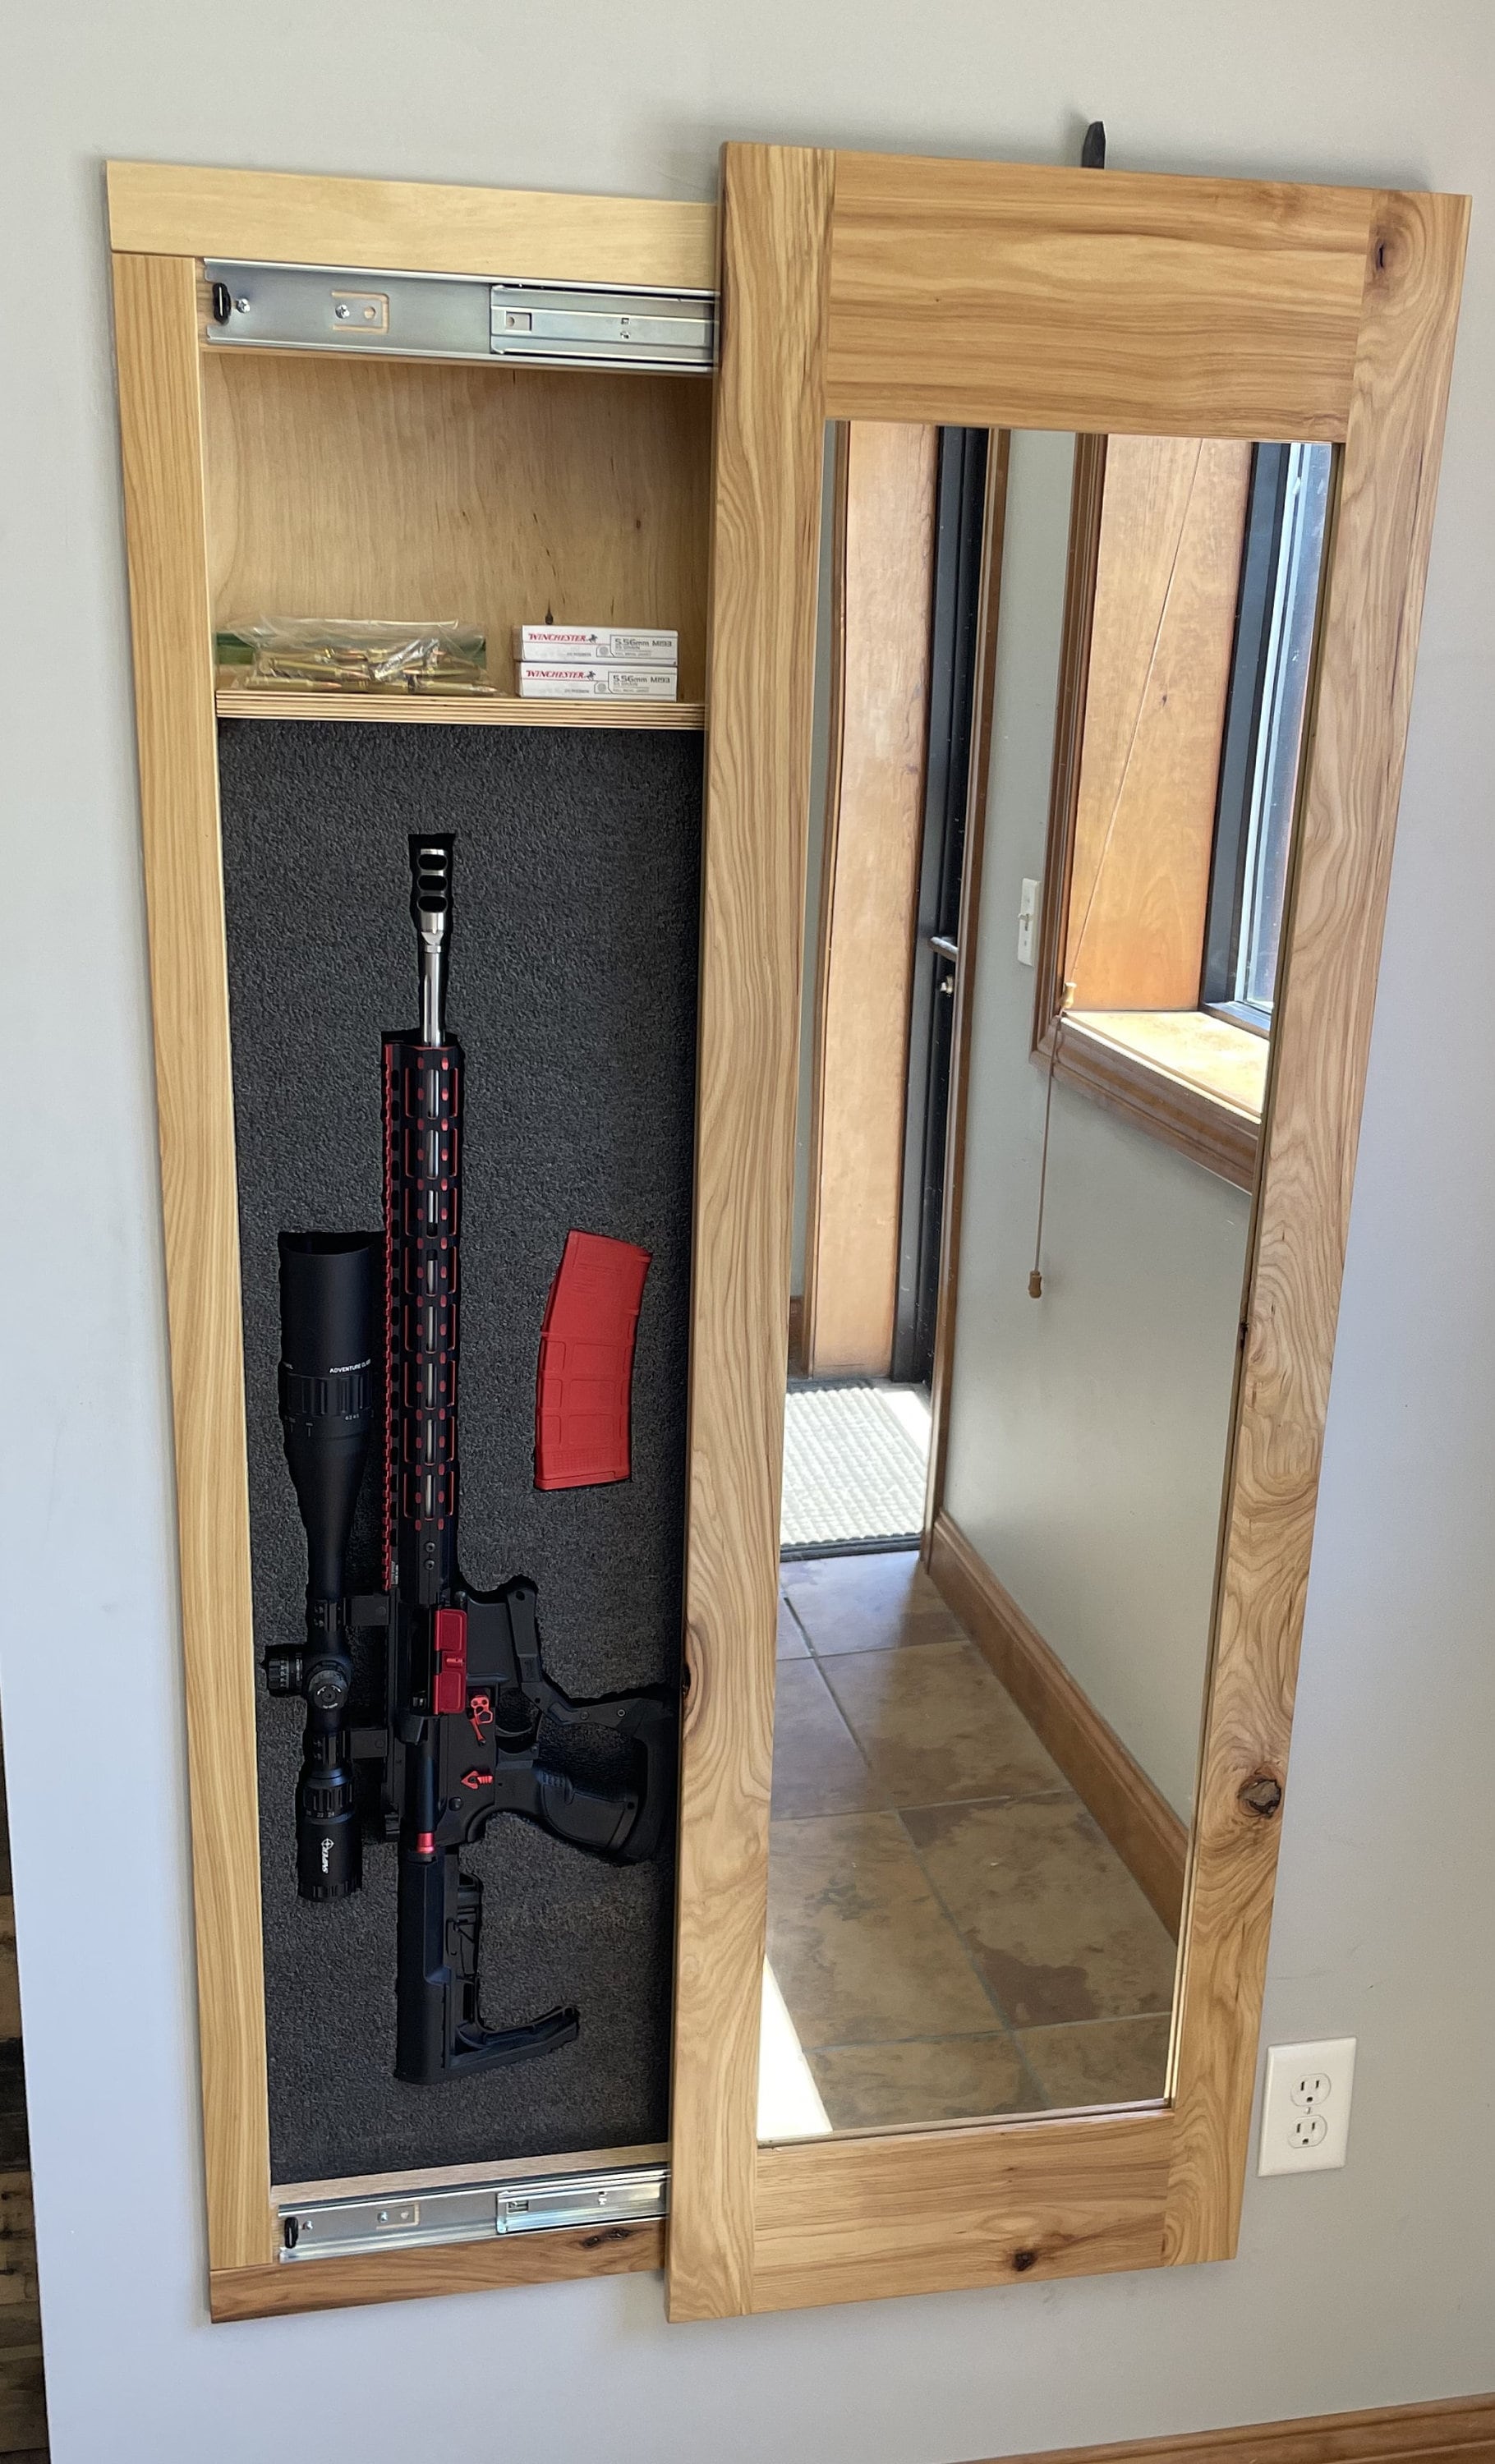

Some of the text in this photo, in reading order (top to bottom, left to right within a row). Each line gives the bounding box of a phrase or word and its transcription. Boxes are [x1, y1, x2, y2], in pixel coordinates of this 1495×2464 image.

[528, 633, 586, 641] WINCHESTER
[526, 670, 584, 678] WINCHESTER
[329, 1363, 361, 1373] ADVENTURE
